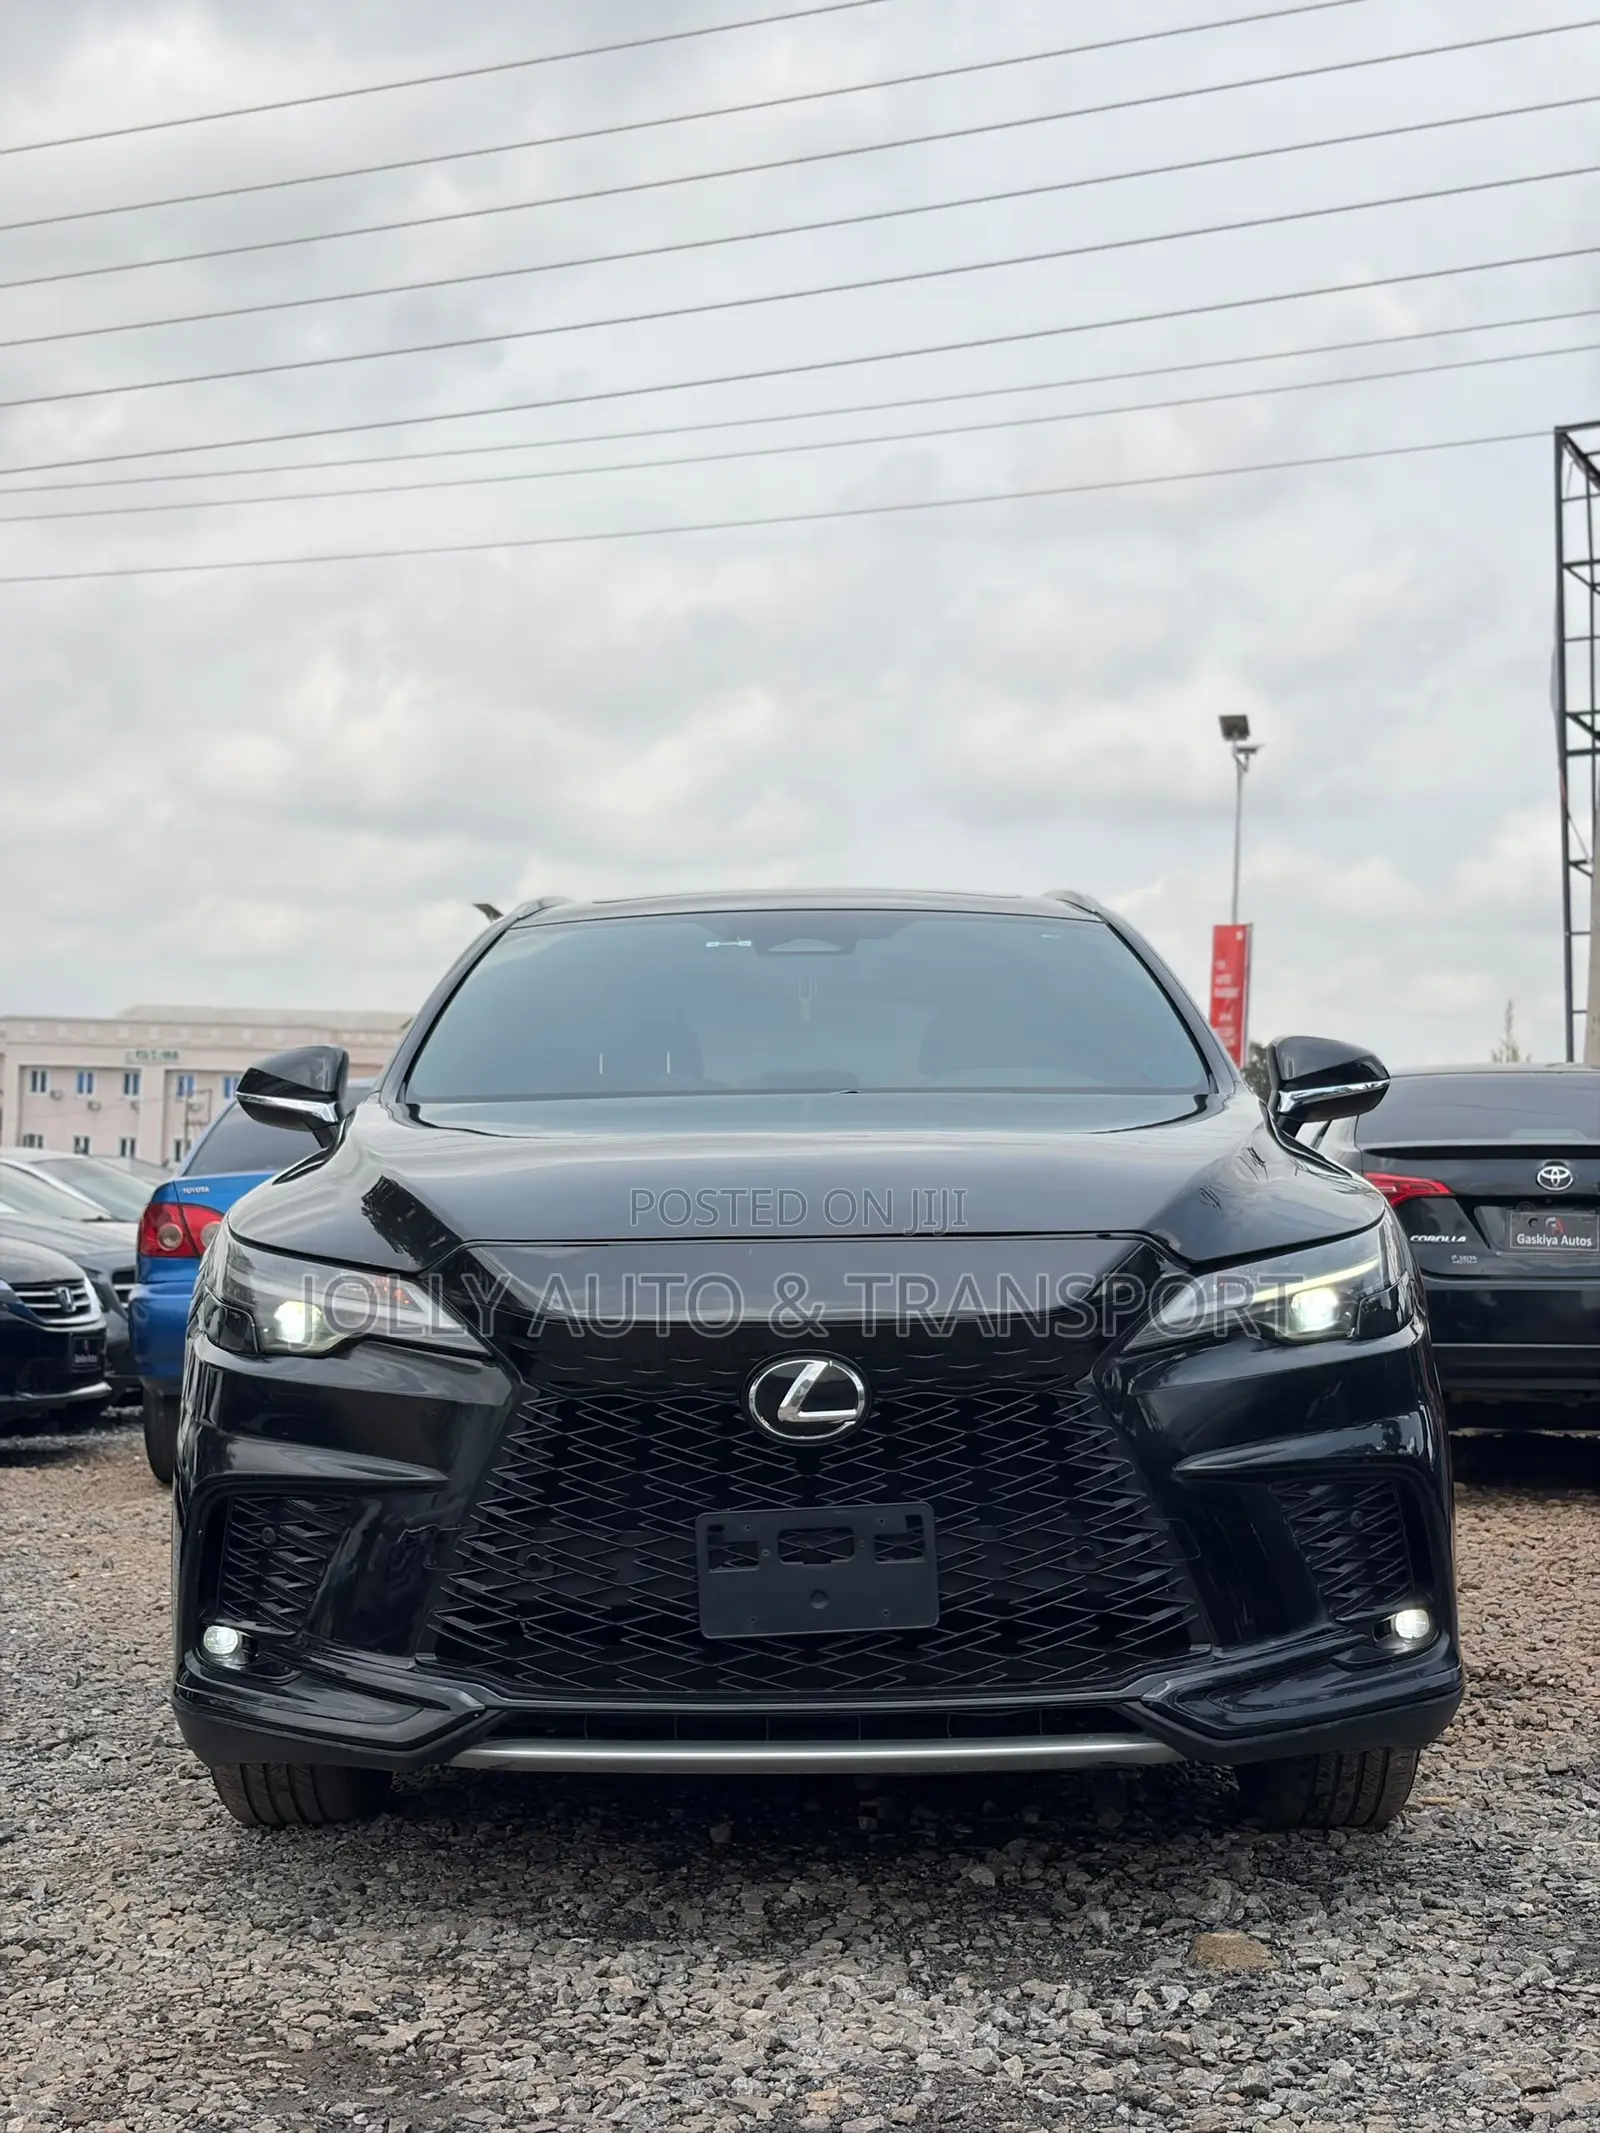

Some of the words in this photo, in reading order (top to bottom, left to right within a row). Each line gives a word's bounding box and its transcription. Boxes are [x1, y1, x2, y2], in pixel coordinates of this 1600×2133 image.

[183, 1186, 210, 1194] TOYOTA
[1410, 1234, 1467, 1242] COROLLA
[1516, 1233, 1558, 1247] Gaskiya
[1560, 1234, 1592, 1247] Autos
